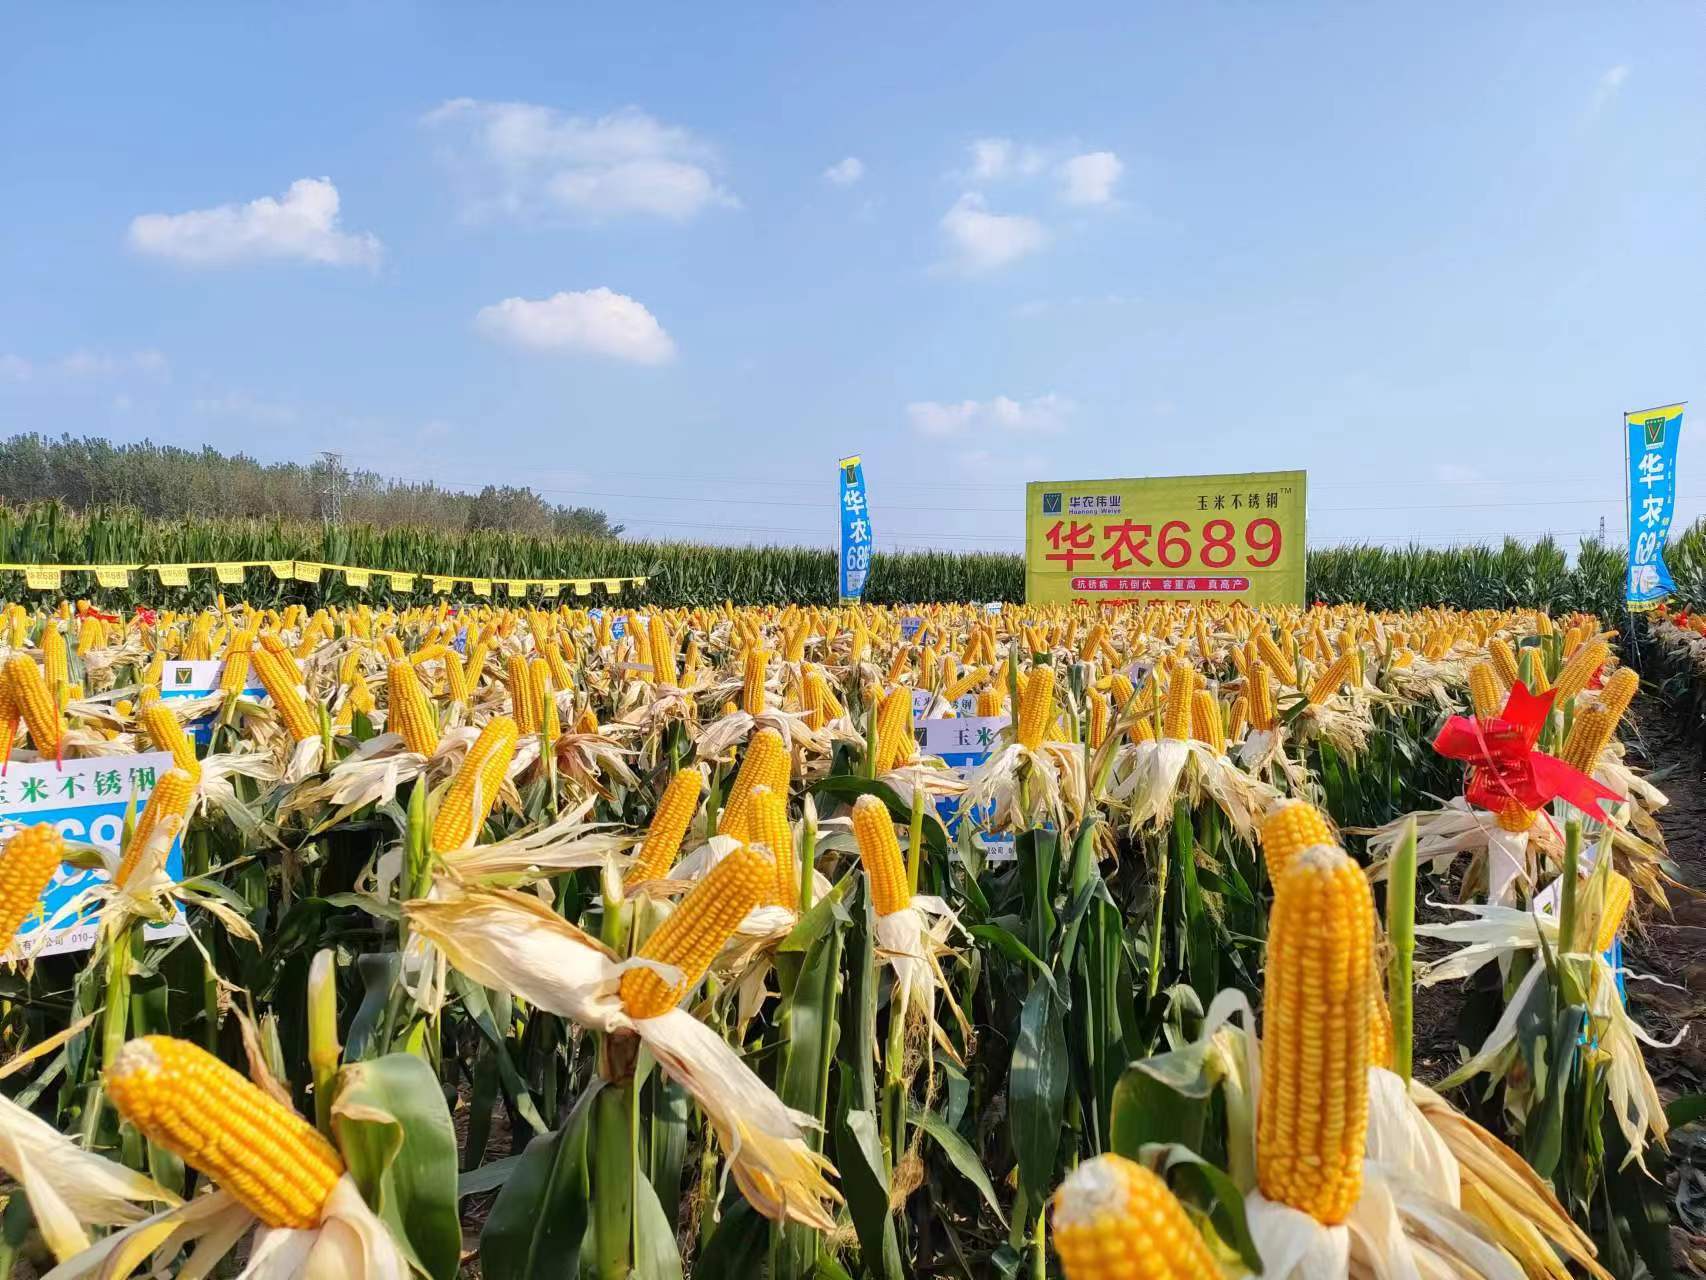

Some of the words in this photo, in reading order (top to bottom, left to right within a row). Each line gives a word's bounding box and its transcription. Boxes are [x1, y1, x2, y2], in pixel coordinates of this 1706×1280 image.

[1070, 496, 1120, 507] 华农伟业
[1196, 492, 1278, 511] 玉米不锈钢
[1045, 518, 1282, 571] 华农689
[1120, 580, 1151, 589] 抗倒伏
[1163, 580, 1196, 589] 容重高
[1208, 579, 1242, 589] 真高产
